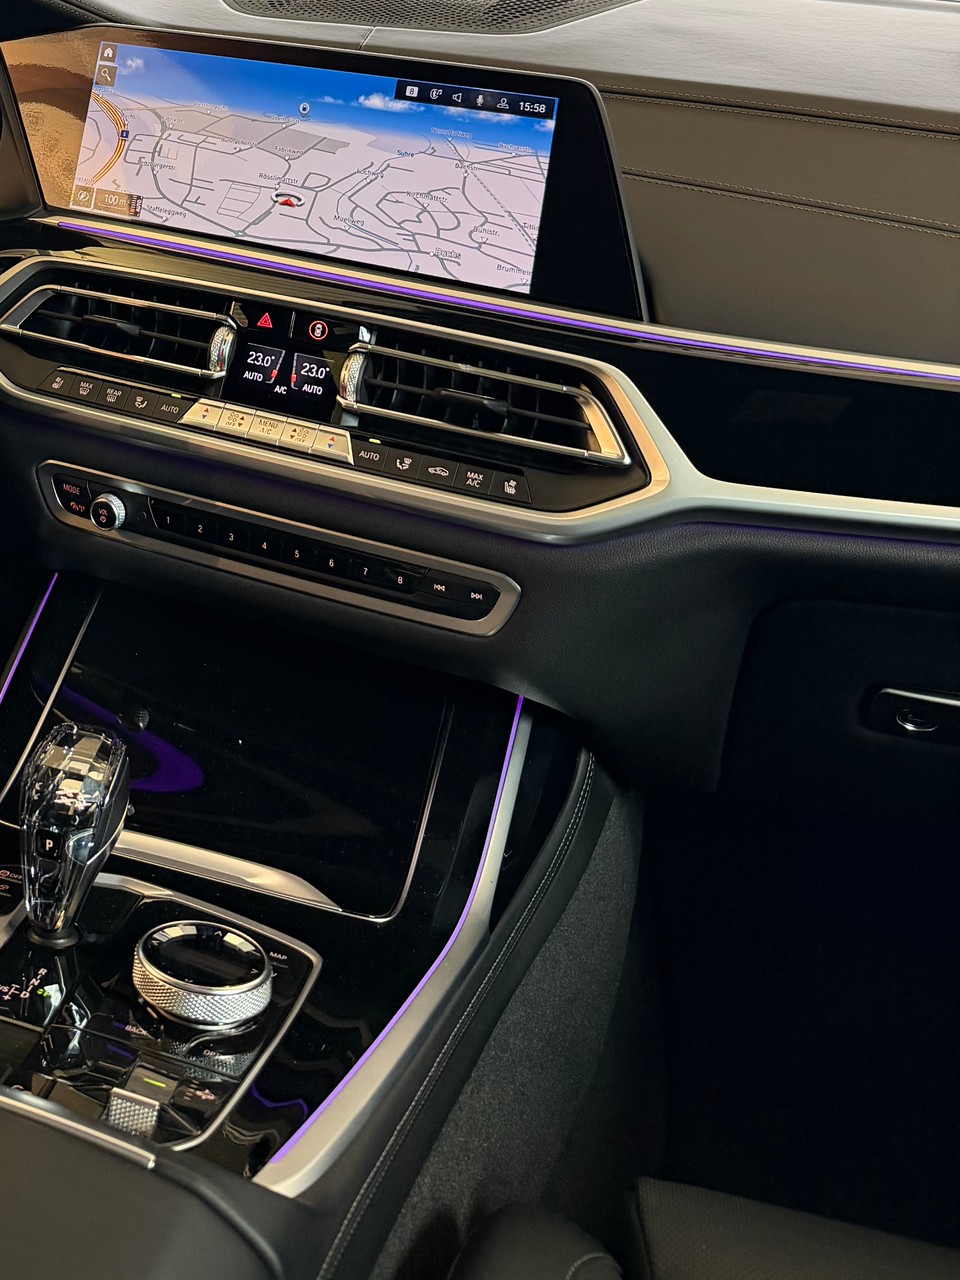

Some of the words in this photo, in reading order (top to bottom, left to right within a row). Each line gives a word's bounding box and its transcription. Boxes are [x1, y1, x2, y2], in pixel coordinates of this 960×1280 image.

[518, 101, 547, 113] 15:58
[397, 149, 415, 158] Suhre
[104, 193, 119, 205] 100
[243, 370, 264, 382] AUTO
[80, 381, 94, 389] MAX
[273, 384, 288, 395] A/C
[301, 383, 323, 395] AUTO
[106, 388, 122, 397] REAR
[160, 404, 179, 414] AUTO
[258, 418, 279, 429] MENU
[259, 427, 272, 436] A/C
[358, 450, 380, 461] AUTO
[466, 471, 484, 482] MAX
[466, 477, 482, 488] A/C
[62, 483, 81, 496] MODE
[98, 507, 109, 516] VOL
[166, 516, 170, 525] 1
[197, 524, 204, 534] 2
[228, 532, 234, 541] 3
[261, 541, 268, 550] 4
[294, 549, 300, 559] 5
[328, 558, 335, 568] 6
[363, 567, 369, 576] 7
[397, 575, 403, 585] 8
[45, 839, 54, 851] P
[269, 951, 288, 961] MAP
[38, 967, 48, 976] R
[20, 990, 30, 999] D
[124, 1023, 147, 1037] BACK
